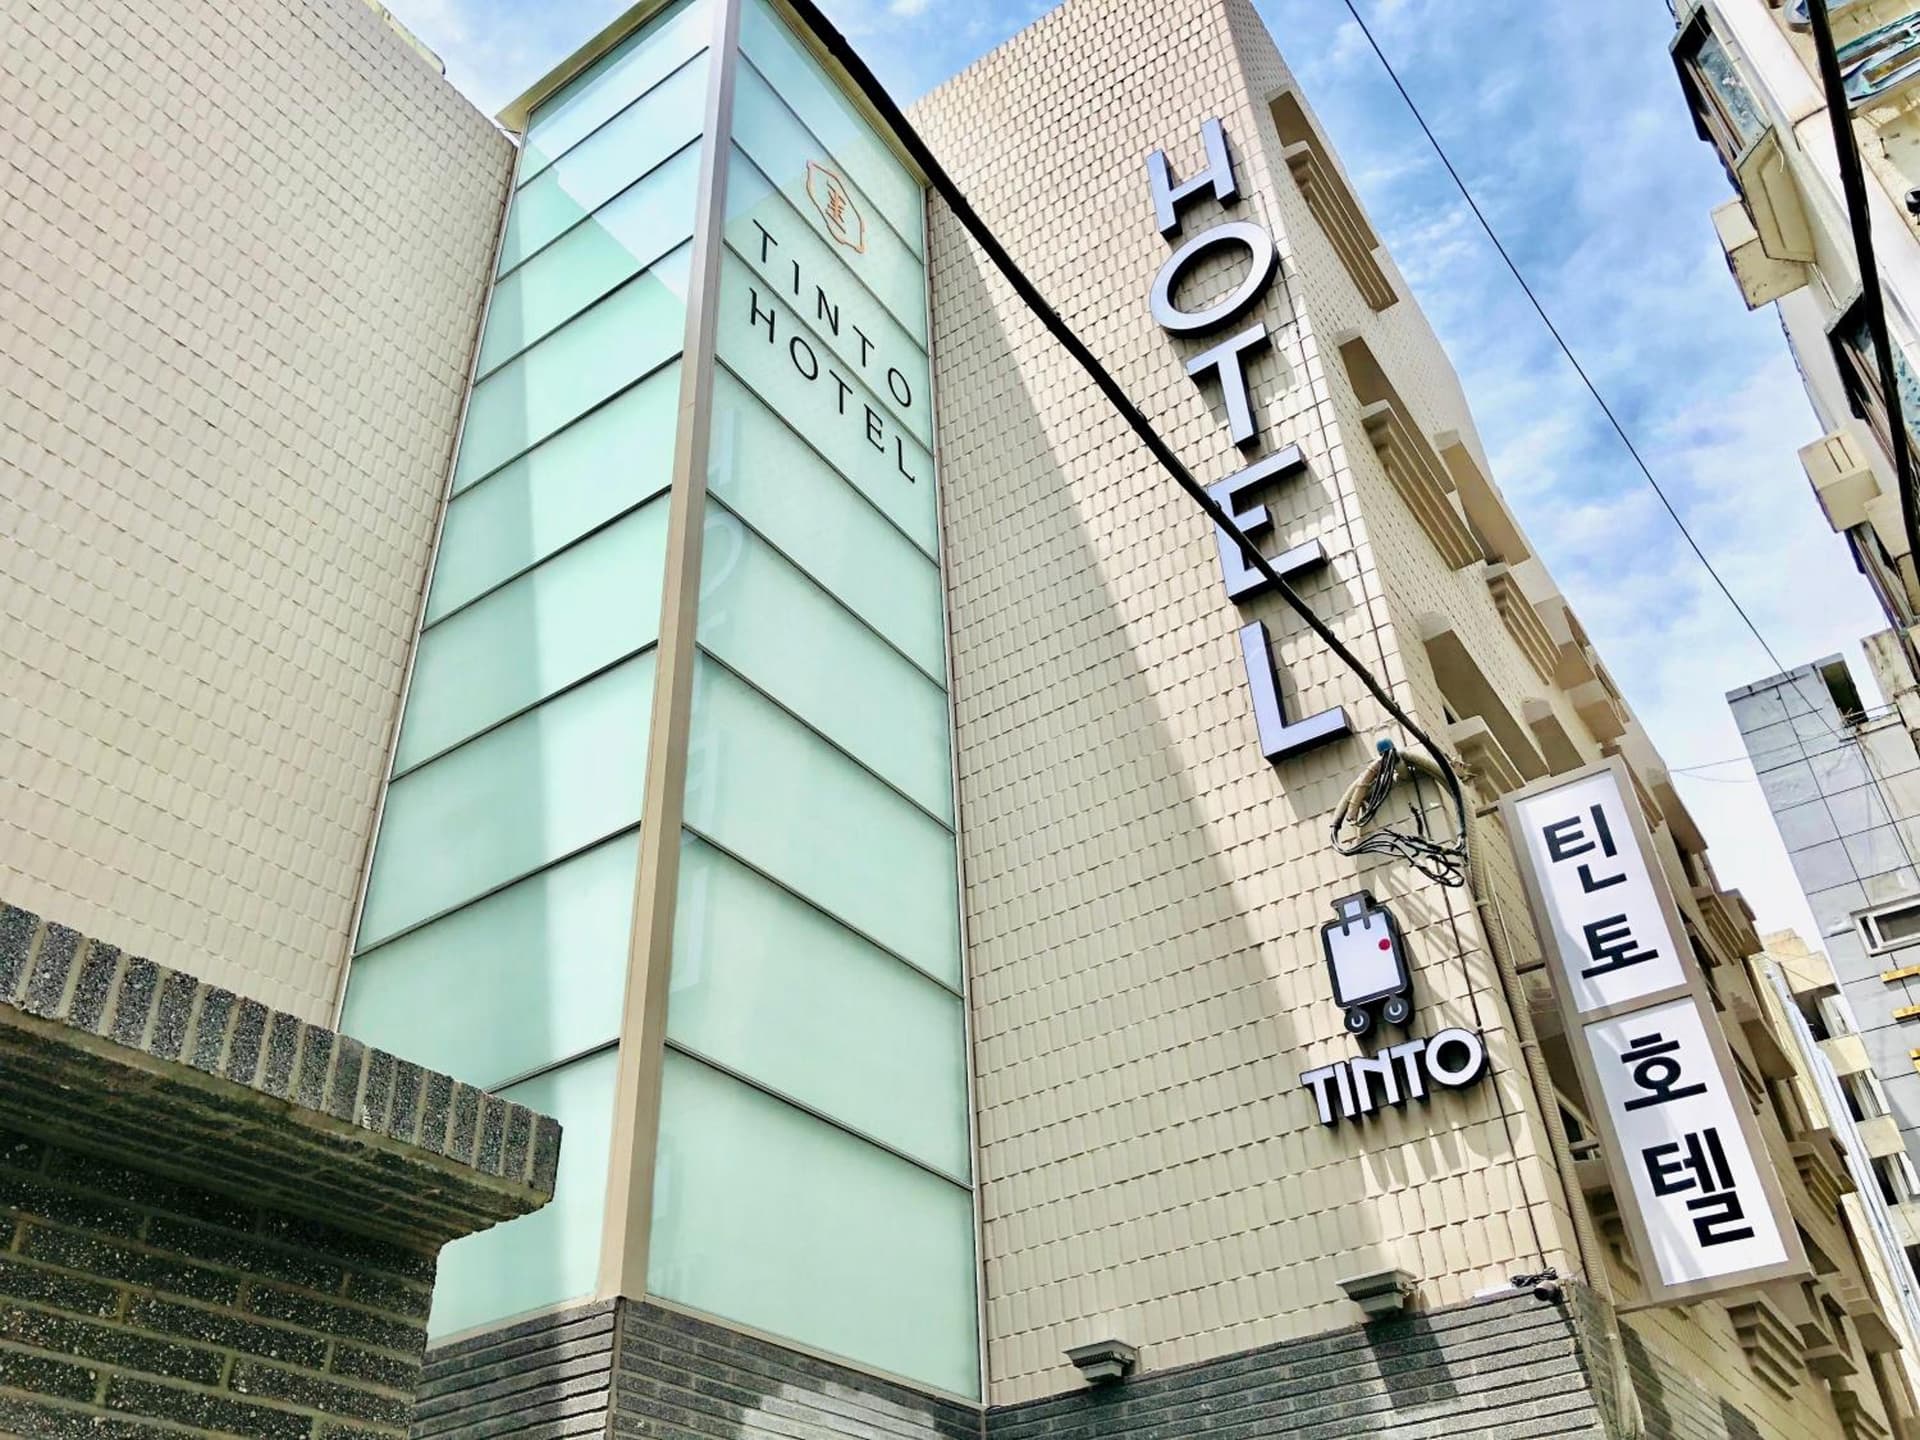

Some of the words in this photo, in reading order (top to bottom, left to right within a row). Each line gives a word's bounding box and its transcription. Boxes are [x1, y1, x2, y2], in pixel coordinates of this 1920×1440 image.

[749, 287, 915, 485] HOTEL
[752, 218, 912, 408] TINTO
[1145, 117, 1352, 763] HOTEL
[1300, 1027, 1486, 1125] TINTO
[1542, 803, 1660, 980] 틴토
[1620, 1032, 1756, 1248] 호텔
